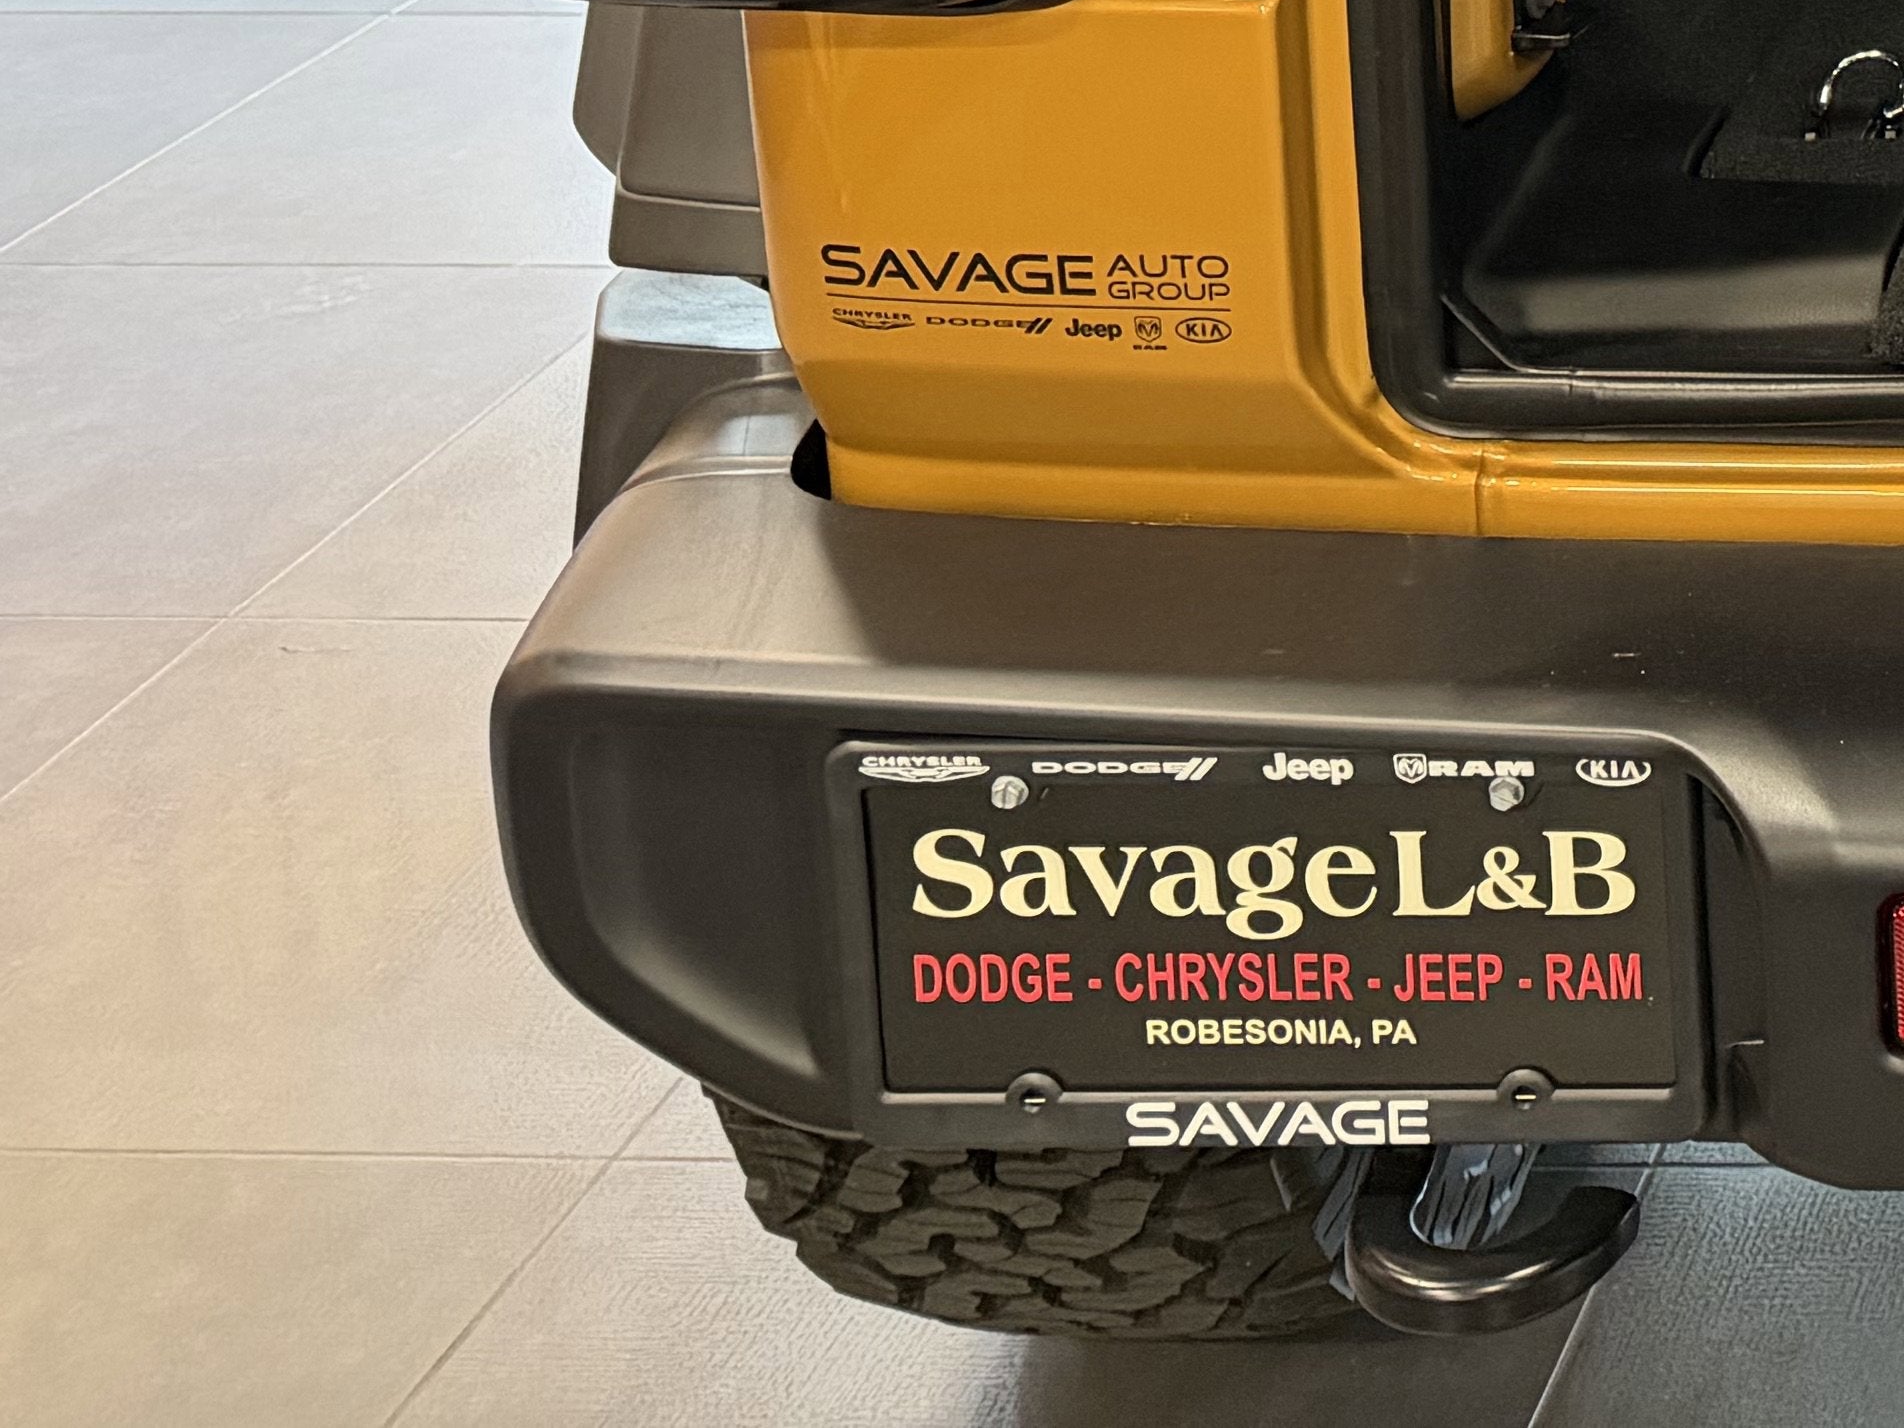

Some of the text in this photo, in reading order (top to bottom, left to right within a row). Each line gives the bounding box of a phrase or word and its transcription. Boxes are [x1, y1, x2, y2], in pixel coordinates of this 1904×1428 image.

[820, 244, 1097, 296] SAVAGE
[1107, 254, 1229, 279] AUTO
[1108, 281, 1231, 301] GROUP
[832, 308, 1224, 341] CHRYSLER DODGE Jeep KIA
[862, 752, 1640, 786] CHRYSLER DODGE Jeep RAM KIA
[913, 829, 1636, 940] Savage L&B
[914, 953, 1073, 1002] DODGE
[1114, 953, 1354, 1002] CHRYSLER
[1394, 954, 1503, 1002] JEEP
[1546, 953, 1643, 1001] RAM
[1146, 1019, 1417, 1048] ROBESONIA, PA
[1126, 1100, 1432, 1147] SAVAGE
